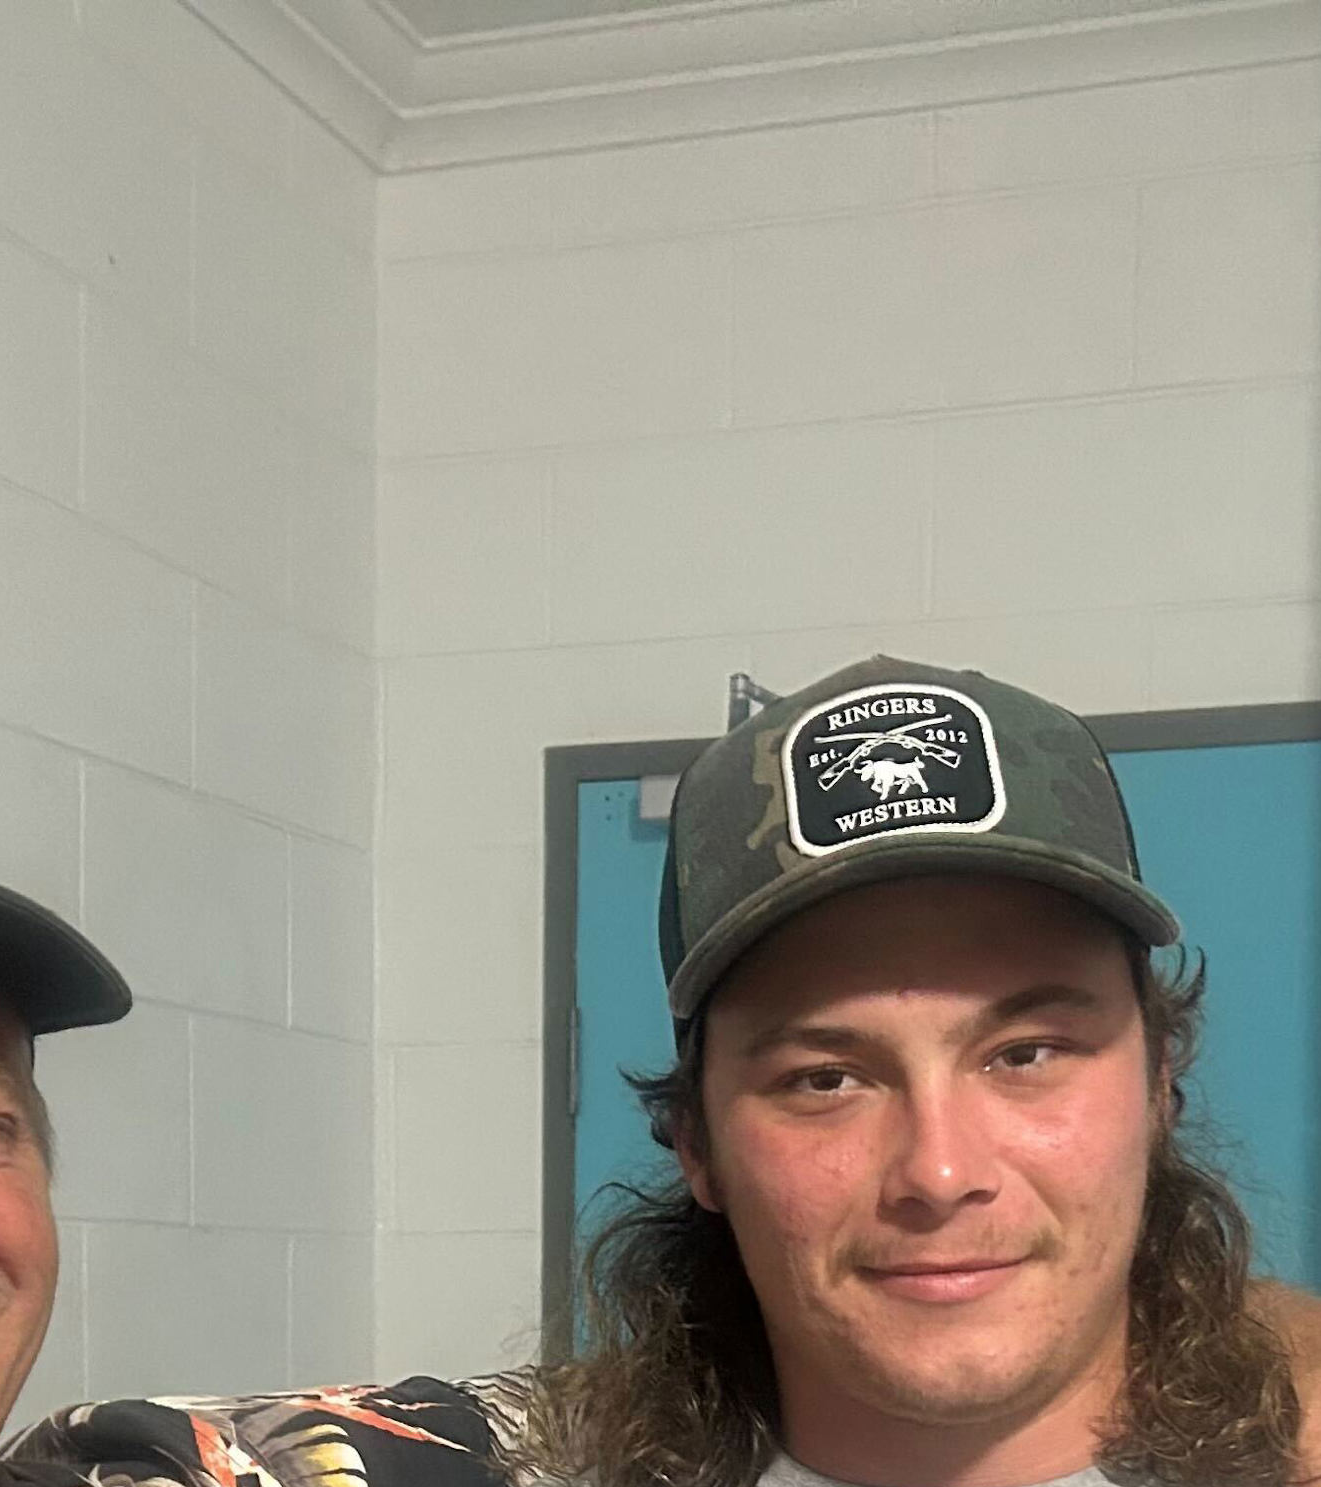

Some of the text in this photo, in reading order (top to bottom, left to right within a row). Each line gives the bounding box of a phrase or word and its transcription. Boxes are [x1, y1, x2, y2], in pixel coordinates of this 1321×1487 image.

[828, 698, 936, 731] RINGERS
[809, 729, 969, 768] Est. 2012
[835, 797, 957, 833] WESTERN
